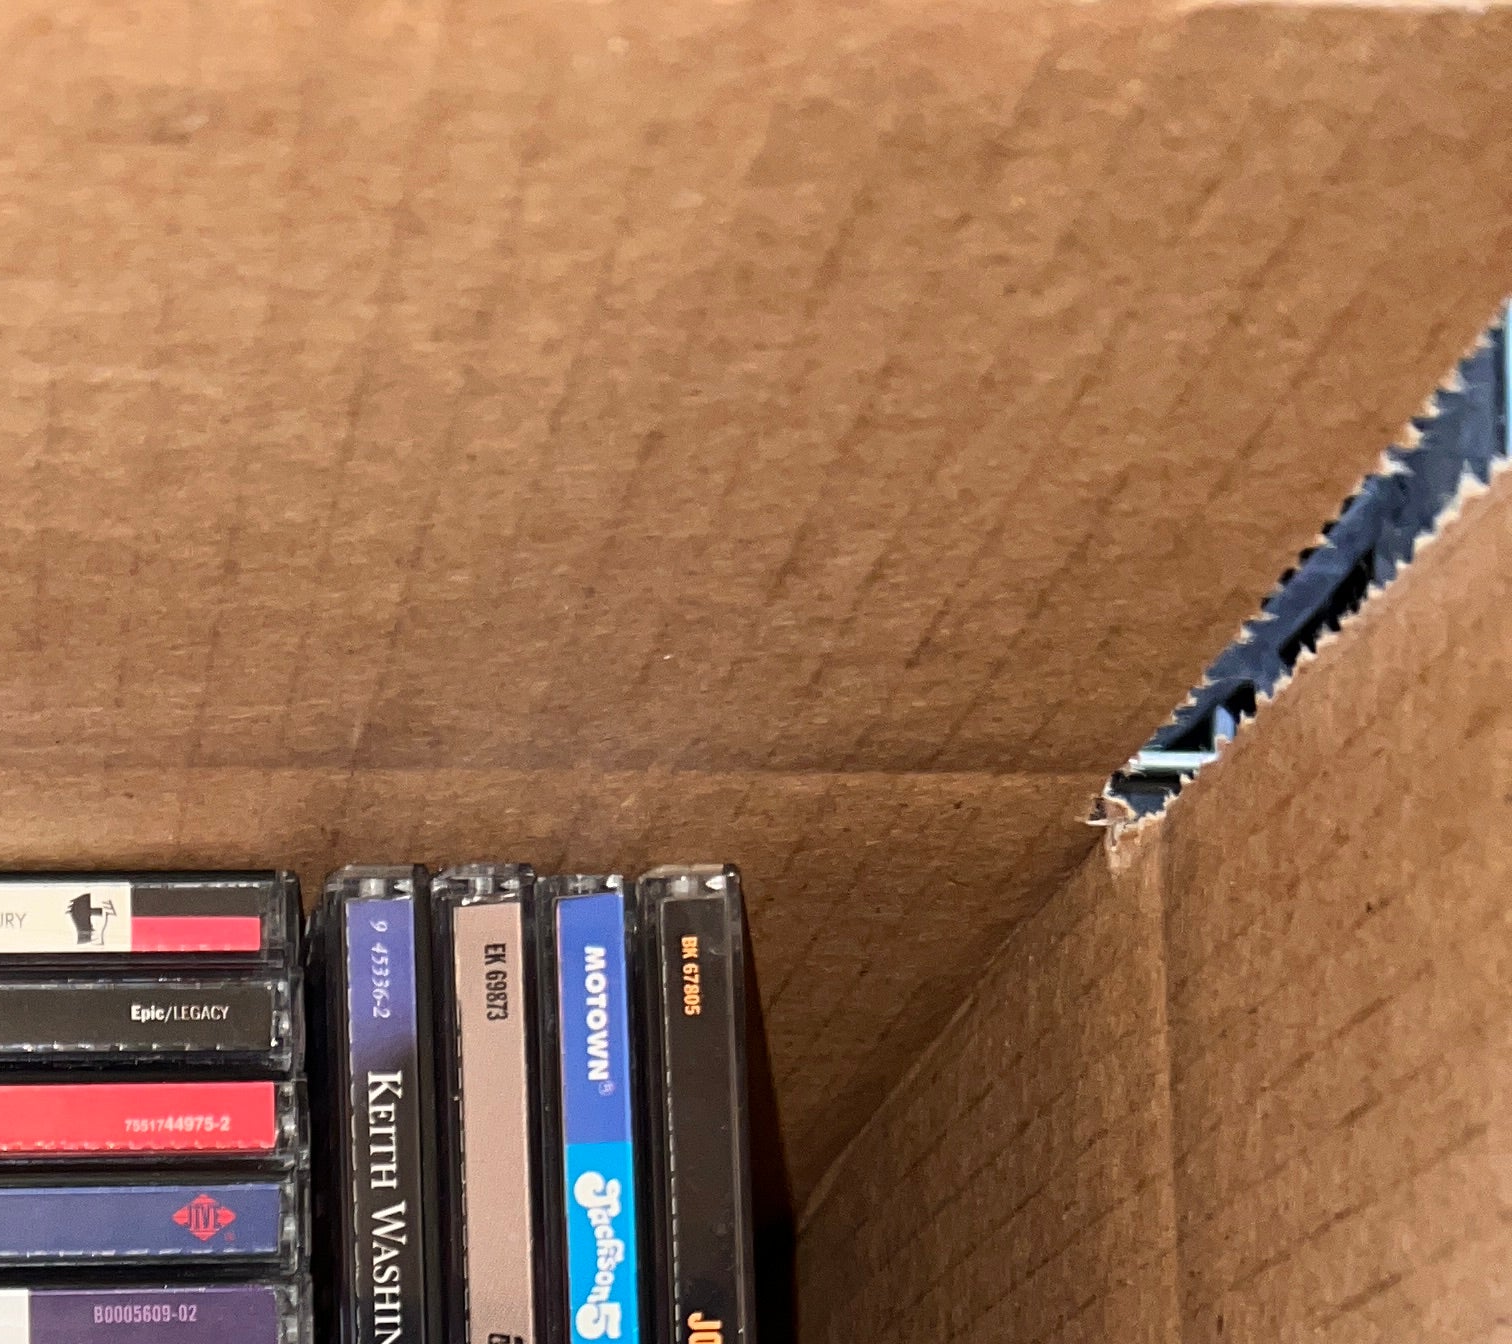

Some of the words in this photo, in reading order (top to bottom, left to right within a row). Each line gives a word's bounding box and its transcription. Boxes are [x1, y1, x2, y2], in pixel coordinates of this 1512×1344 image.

[372, 942, 390, 1018] 45336-2
[487, 969, 508, 1021] 69873
[683, 962, 700, 1015] 67805
[131, 1005, 229, 1023] Epic/LEGACY
[367, 1071, 403, 1189] KEITH
[94, 1305, 197, 1323] B0005609-02
